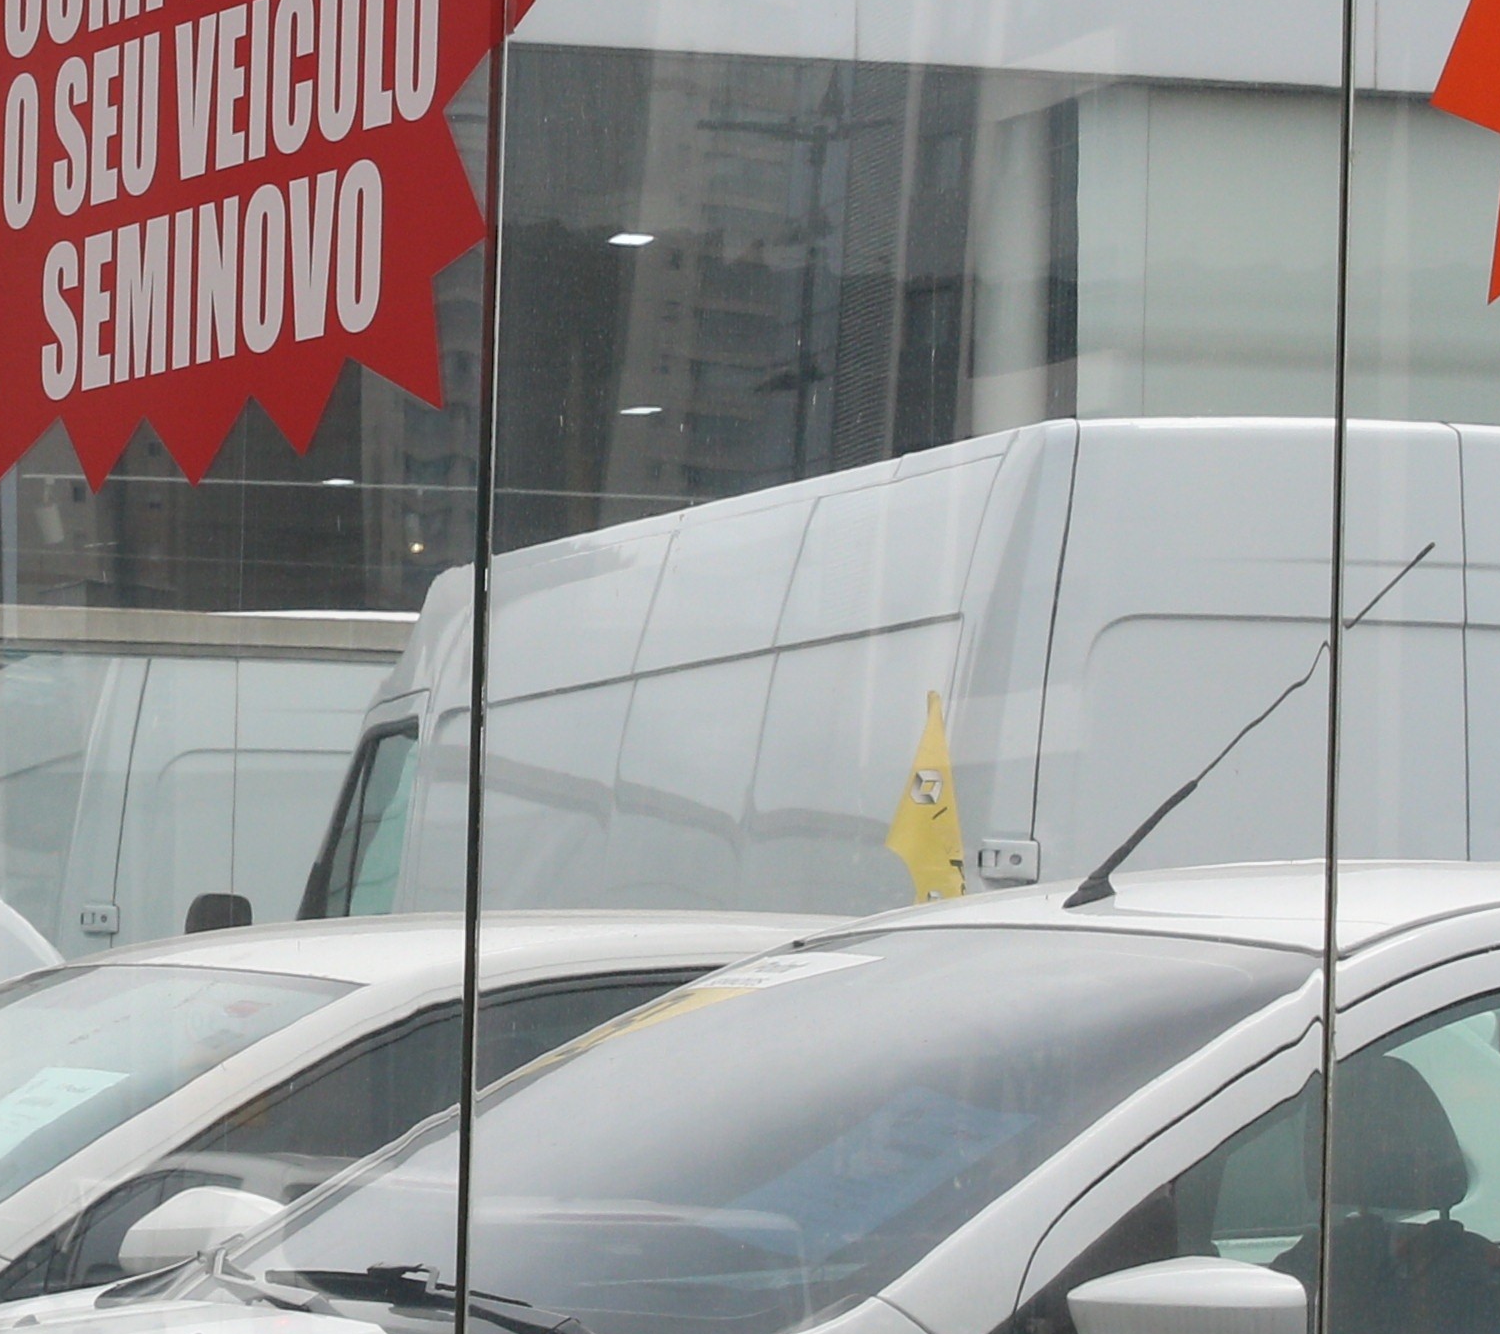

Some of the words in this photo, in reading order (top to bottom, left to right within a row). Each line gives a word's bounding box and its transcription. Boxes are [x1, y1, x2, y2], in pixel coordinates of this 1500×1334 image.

[4, 72, 40, 230] O
[53, 41, 160, 217] SEU
[41, 159, 384, 401] SEMINOVO
